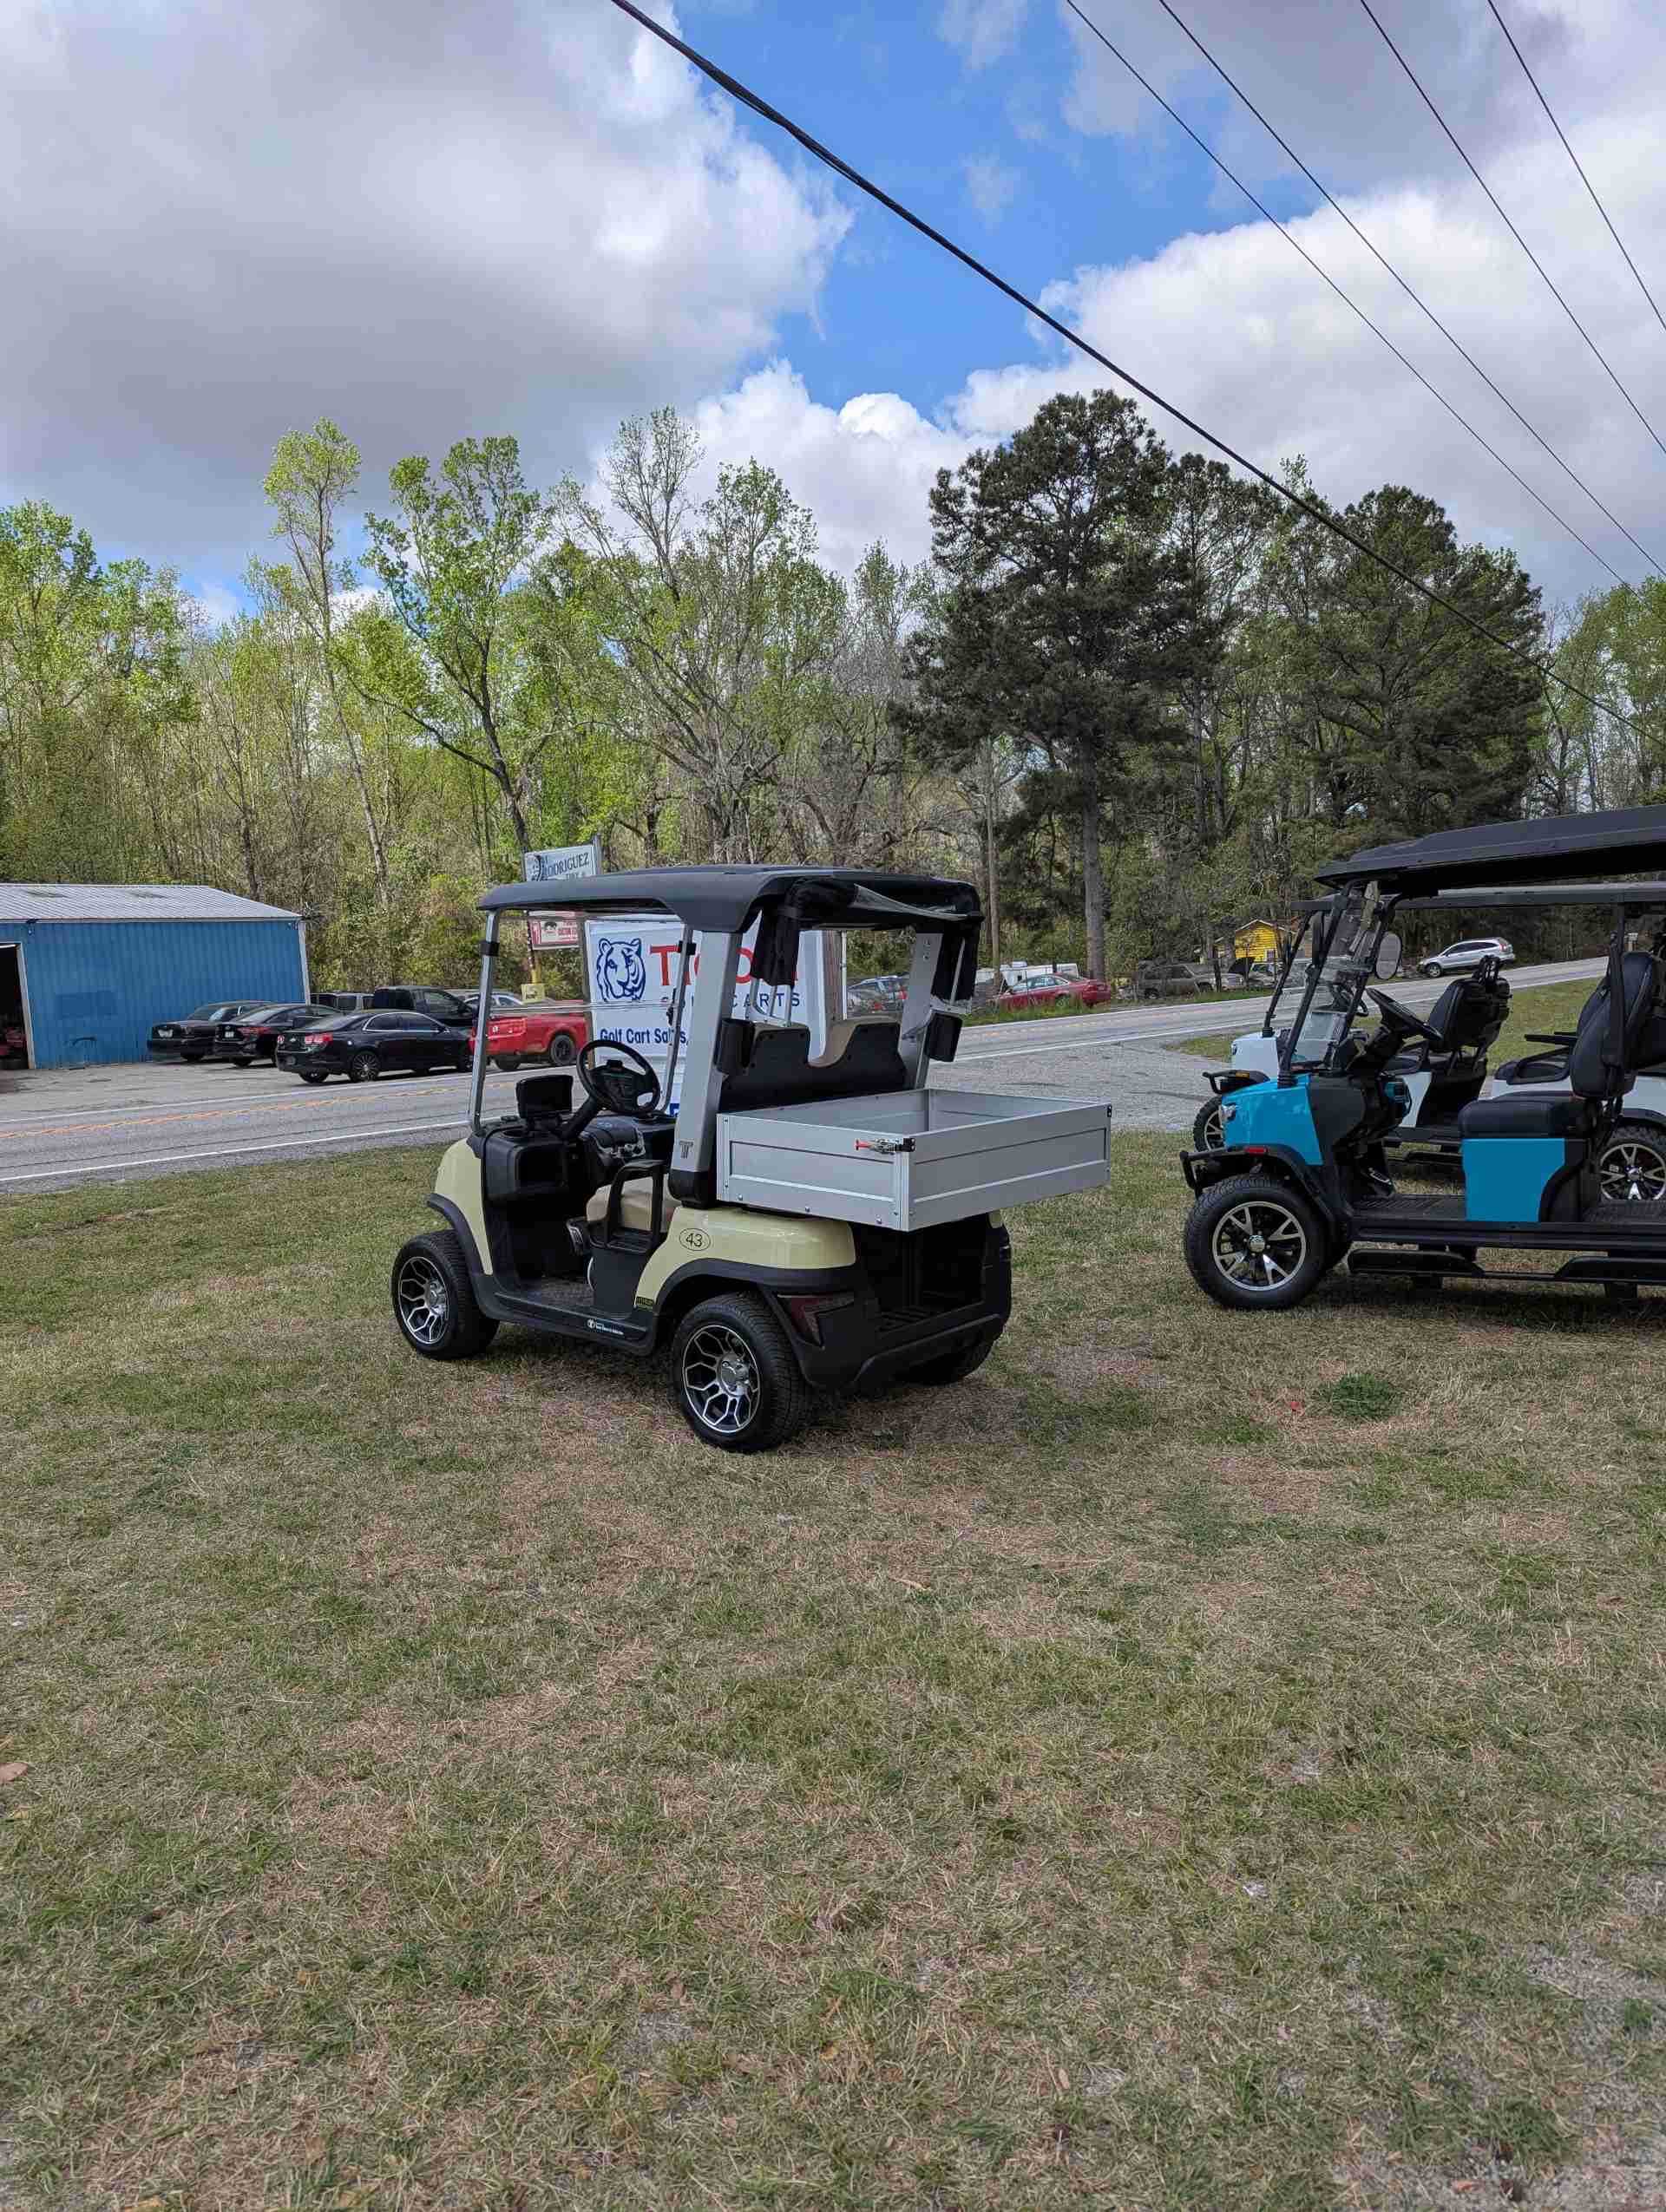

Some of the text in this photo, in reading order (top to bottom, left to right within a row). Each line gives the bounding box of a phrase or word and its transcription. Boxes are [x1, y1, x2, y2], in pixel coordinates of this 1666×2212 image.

[600, 1028, 688, 1046] Golf Cart Sals,
[685, 1233, 702, 1247] 43
